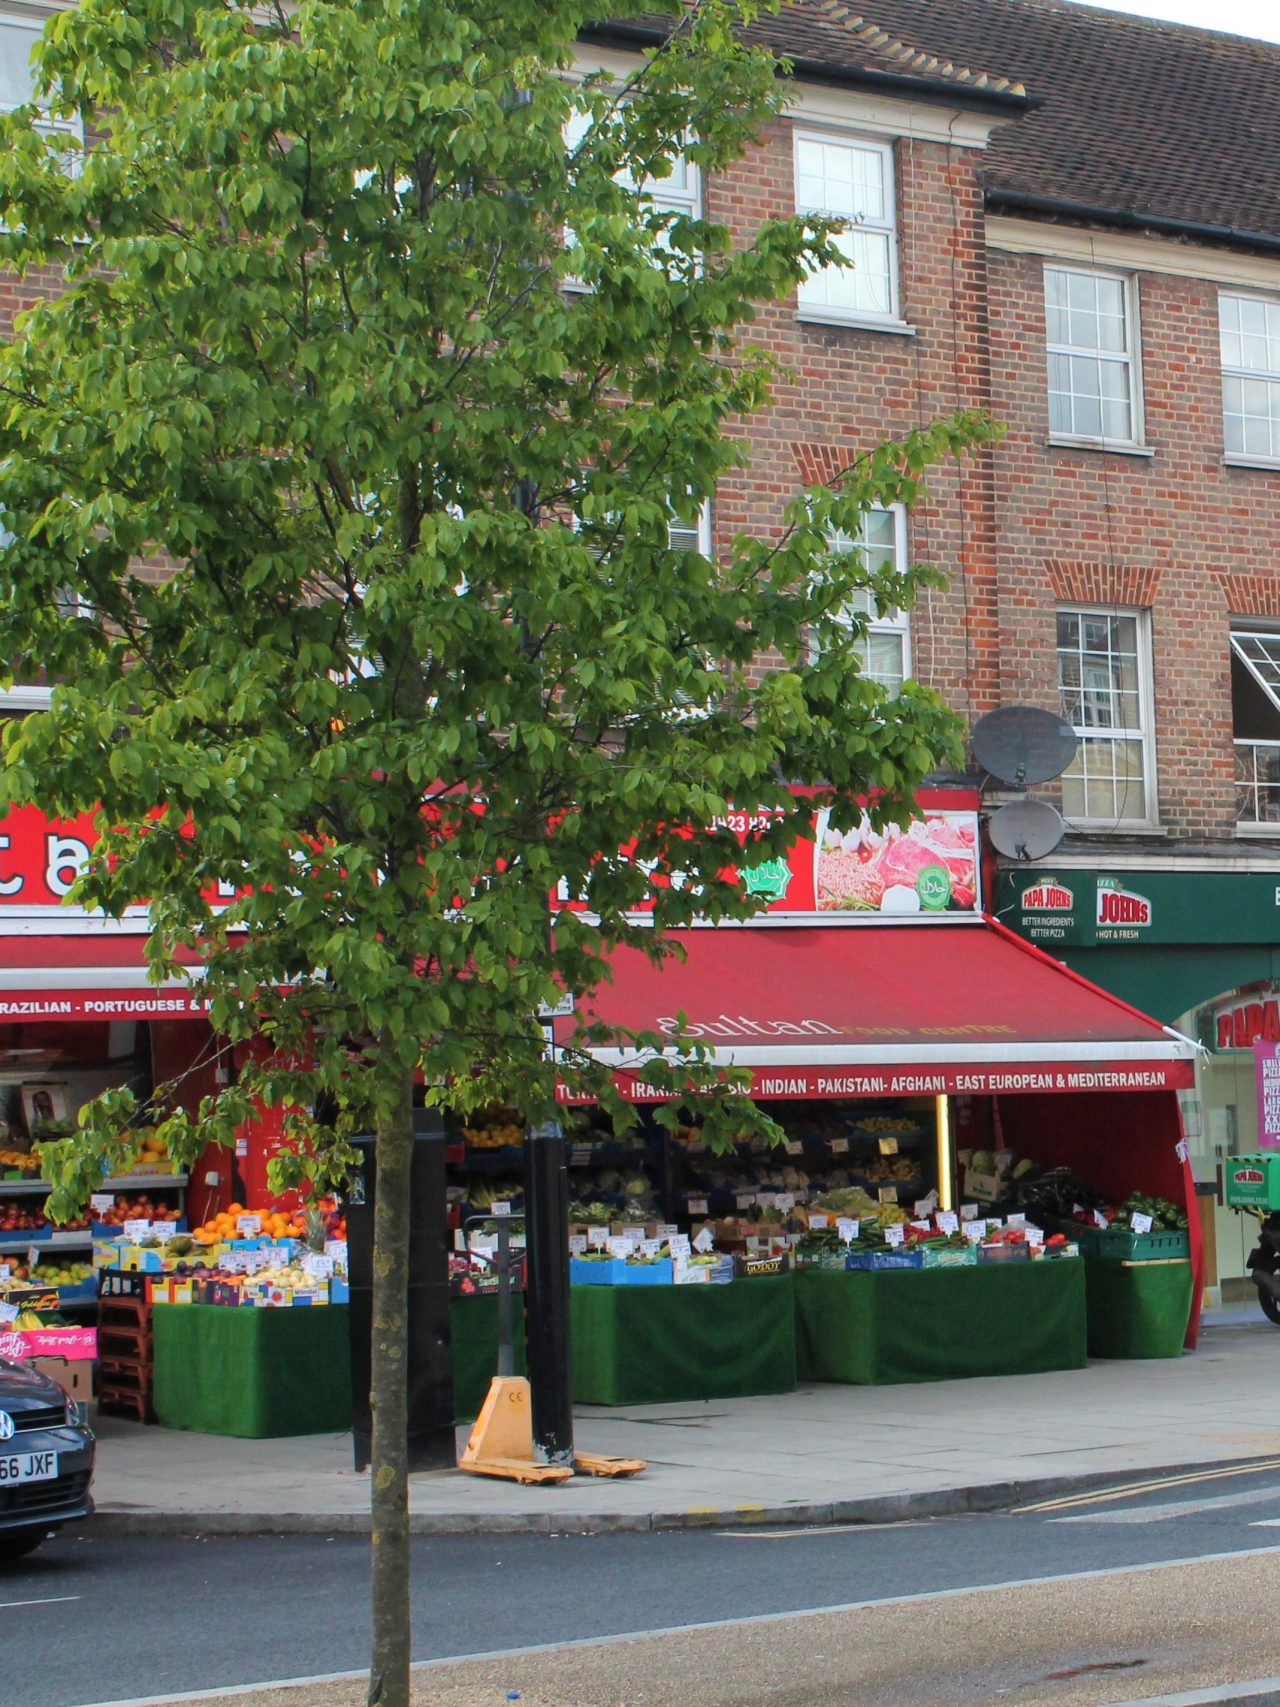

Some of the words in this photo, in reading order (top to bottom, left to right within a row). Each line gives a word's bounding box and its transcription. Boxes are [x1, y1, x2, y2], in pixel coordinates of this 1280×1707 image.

[1024, 888, 1044, 908] PAPA
[1022, 917, 1042, 926] BETTER
[1042, 917, 1074, 926] INGREDIENTS
[1030, 929, 1050, 937] BETTER
[1050, 929, 1065, 938] PIZZA
[1099, 930, 1113, 938] HOT
[1119, 930, 1139, 938] FRESH
[0, 1001, 71, 1014] RAZILIAN
[84, 1000, 185, 1014] PORTUGUESE
[189, 1000, 200, 1011] &
[656, 1014, 844, 1038] Sultan
[845, 1025, 910, 1036] FOOD
[919, 1024, 1018, 1036] CENTRE
[1217, 1000, 1280, 1048] PAPA
[761, 1078, 807, 1096] INDIAN
[890, 1075, 946, 1092] AFGHANI
[956, 1074, 986, 1090] EAST
[988, 1072, 1054, 1090] EUROPEAN
[1056, 1072, 1066, 1088] &
[1067, 1071, 1166, 1088] MEDITERRANEAN
[746, 1262, 781, 1273] GODOY
[509, 1392, 522, 1402] CE
[0, 1458, 19, 1480] 66
[25, 1454, 54, 1476] JXF
